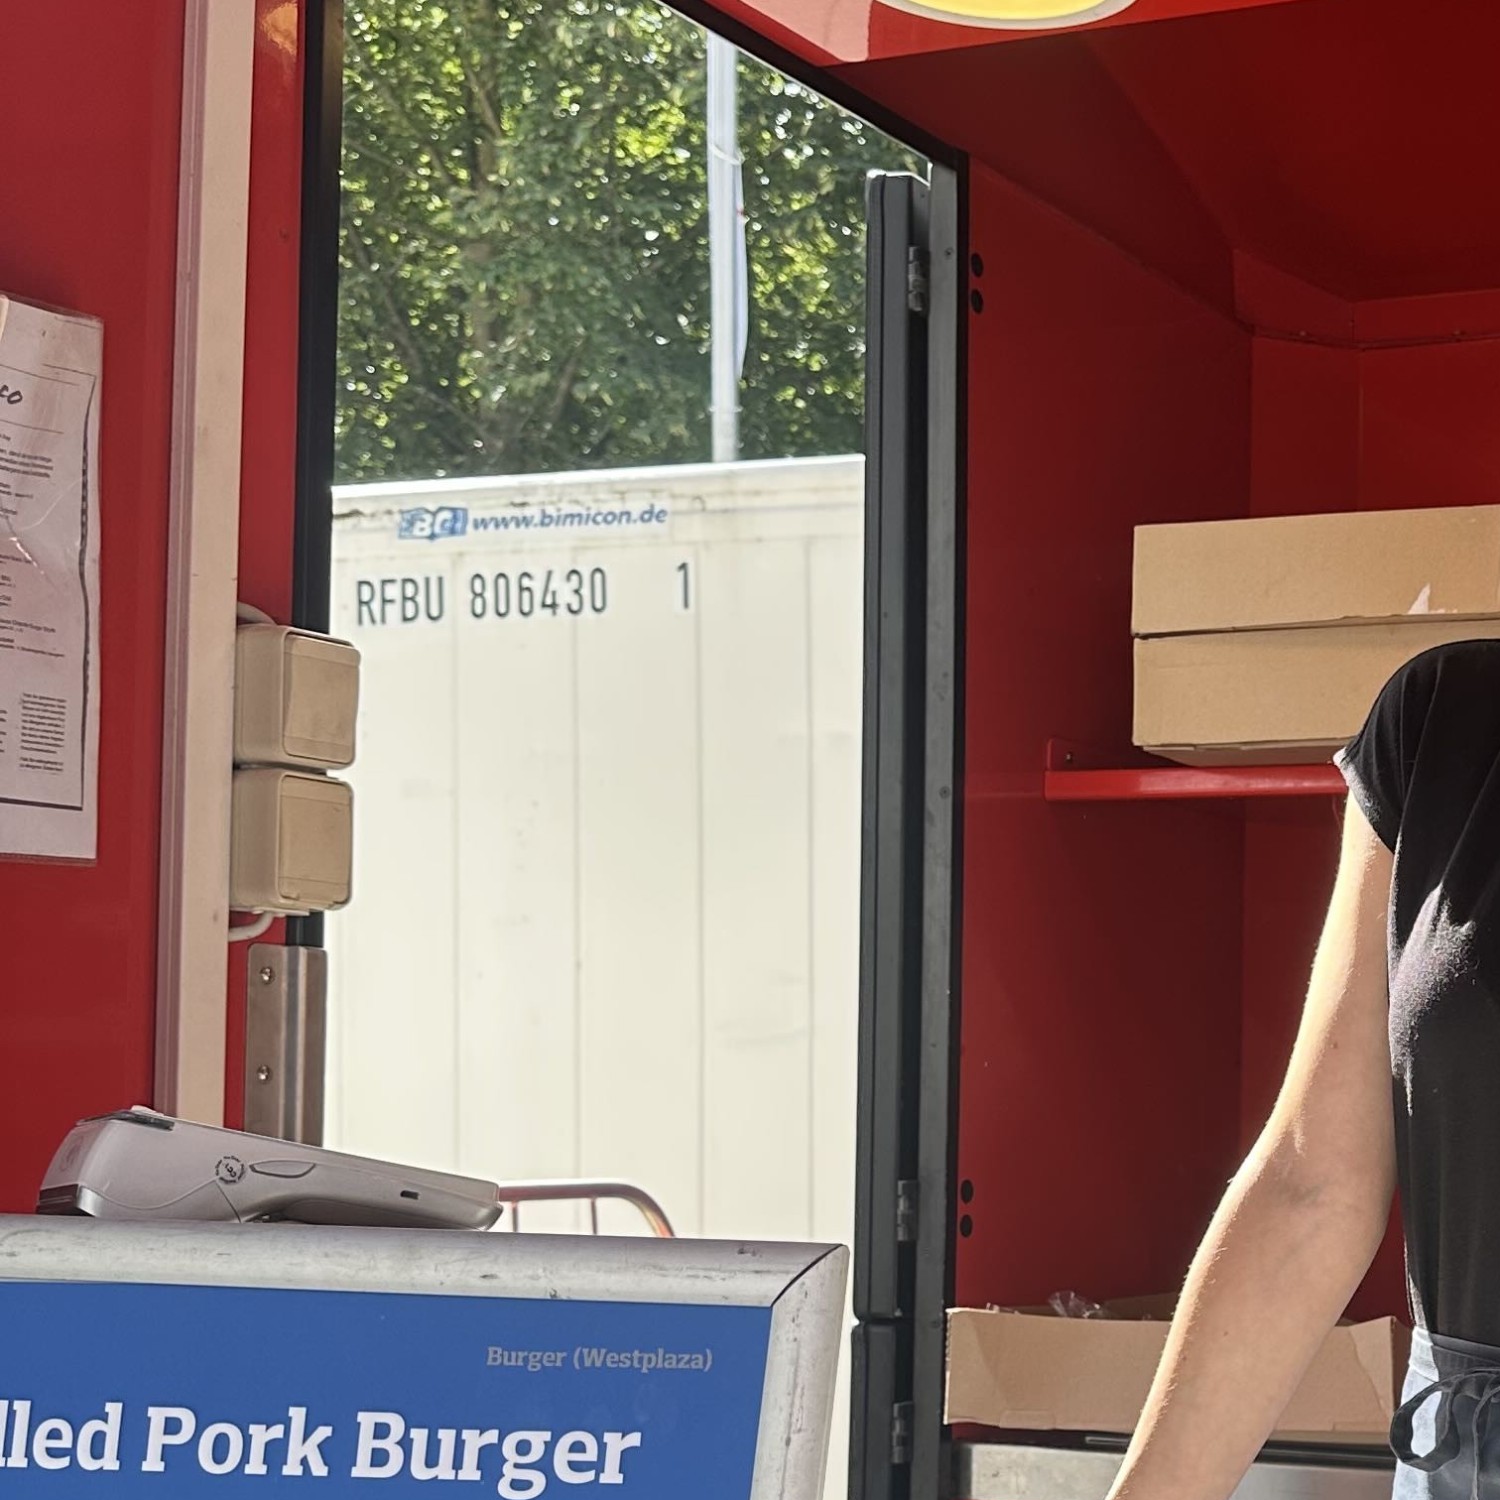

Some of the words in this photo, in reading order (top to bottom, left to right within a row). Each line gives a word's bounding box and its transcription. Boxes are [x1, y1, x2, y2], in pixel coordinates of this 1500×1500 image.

[472, 503, 669, 531] www.bimicon.de
[357, 576, 445, 626] RFBU
[470, 567, 608, 619] 806430
[676, 561, 690, 610] 1
[486, 1347, 567, 1372] Burger
[572, 1347, 714, 1374] (Westplaza)
[141, 1406, 334, 1477] Pork
[350, 1411, 643, 1500] Burger
